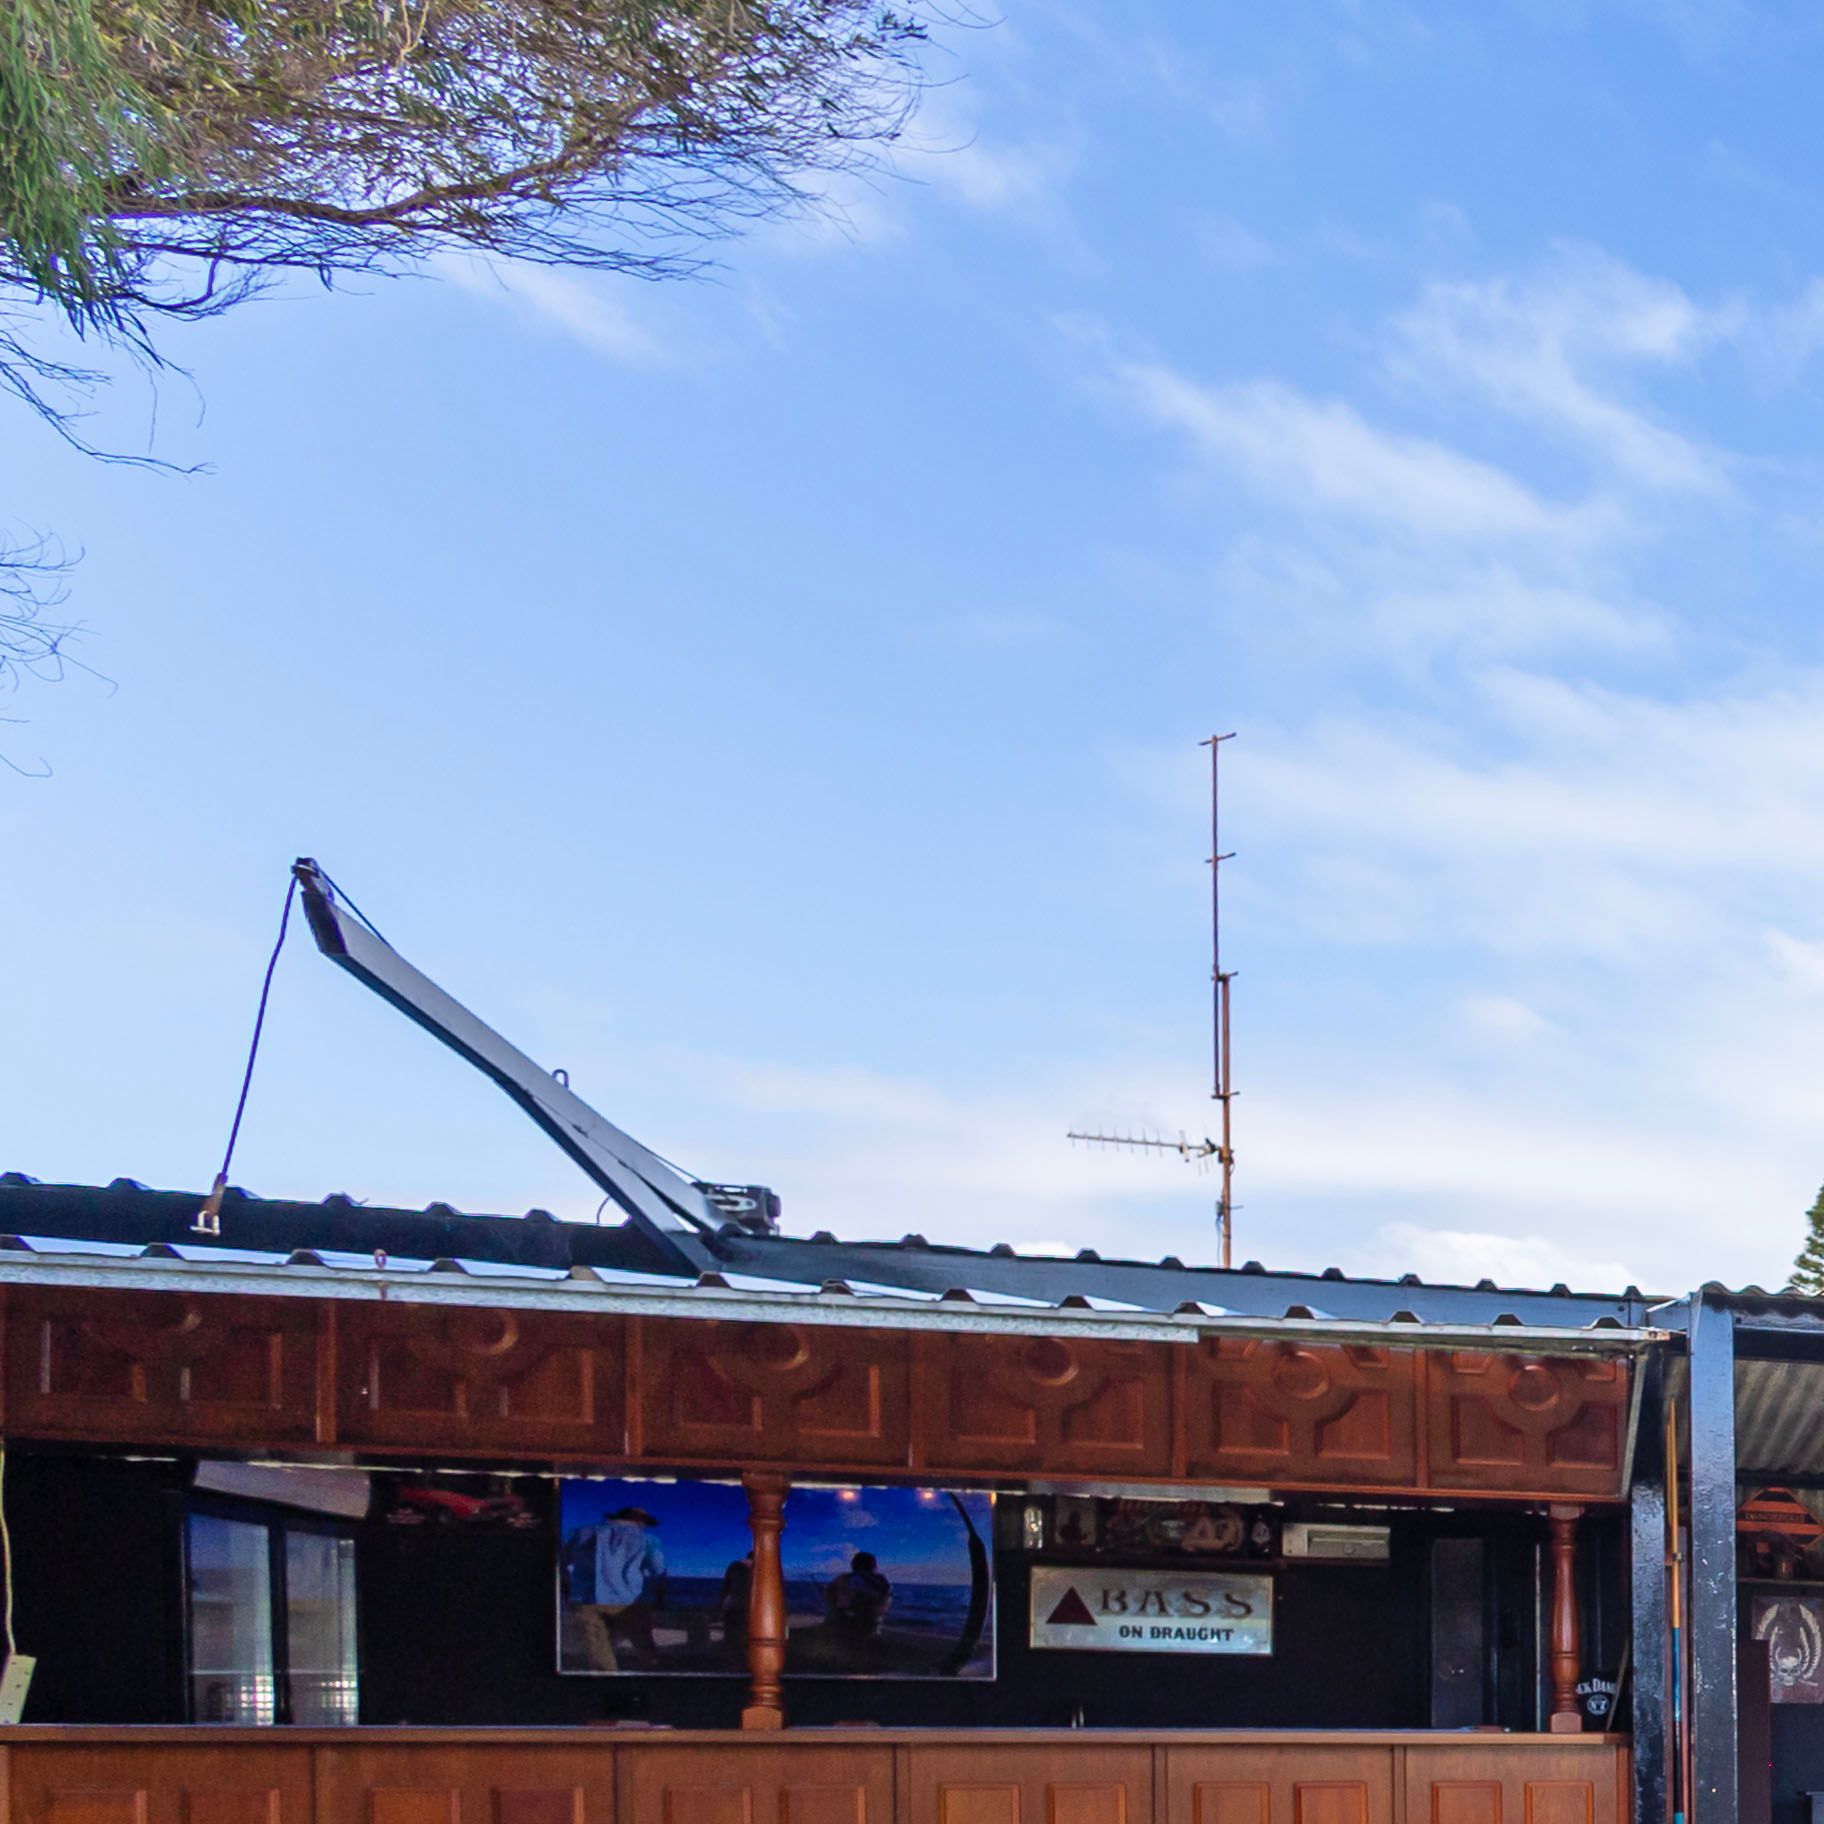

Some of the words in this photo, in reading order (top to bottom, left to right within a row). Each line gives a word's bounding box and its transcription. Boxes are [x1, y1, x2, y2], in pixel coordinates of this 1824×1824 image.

[1099, 1588, 1254, 1619] BASS
[1119, 1625, 1143, 1638] ON
[1150, 1626, 1234, 1641] DRAUGHT
